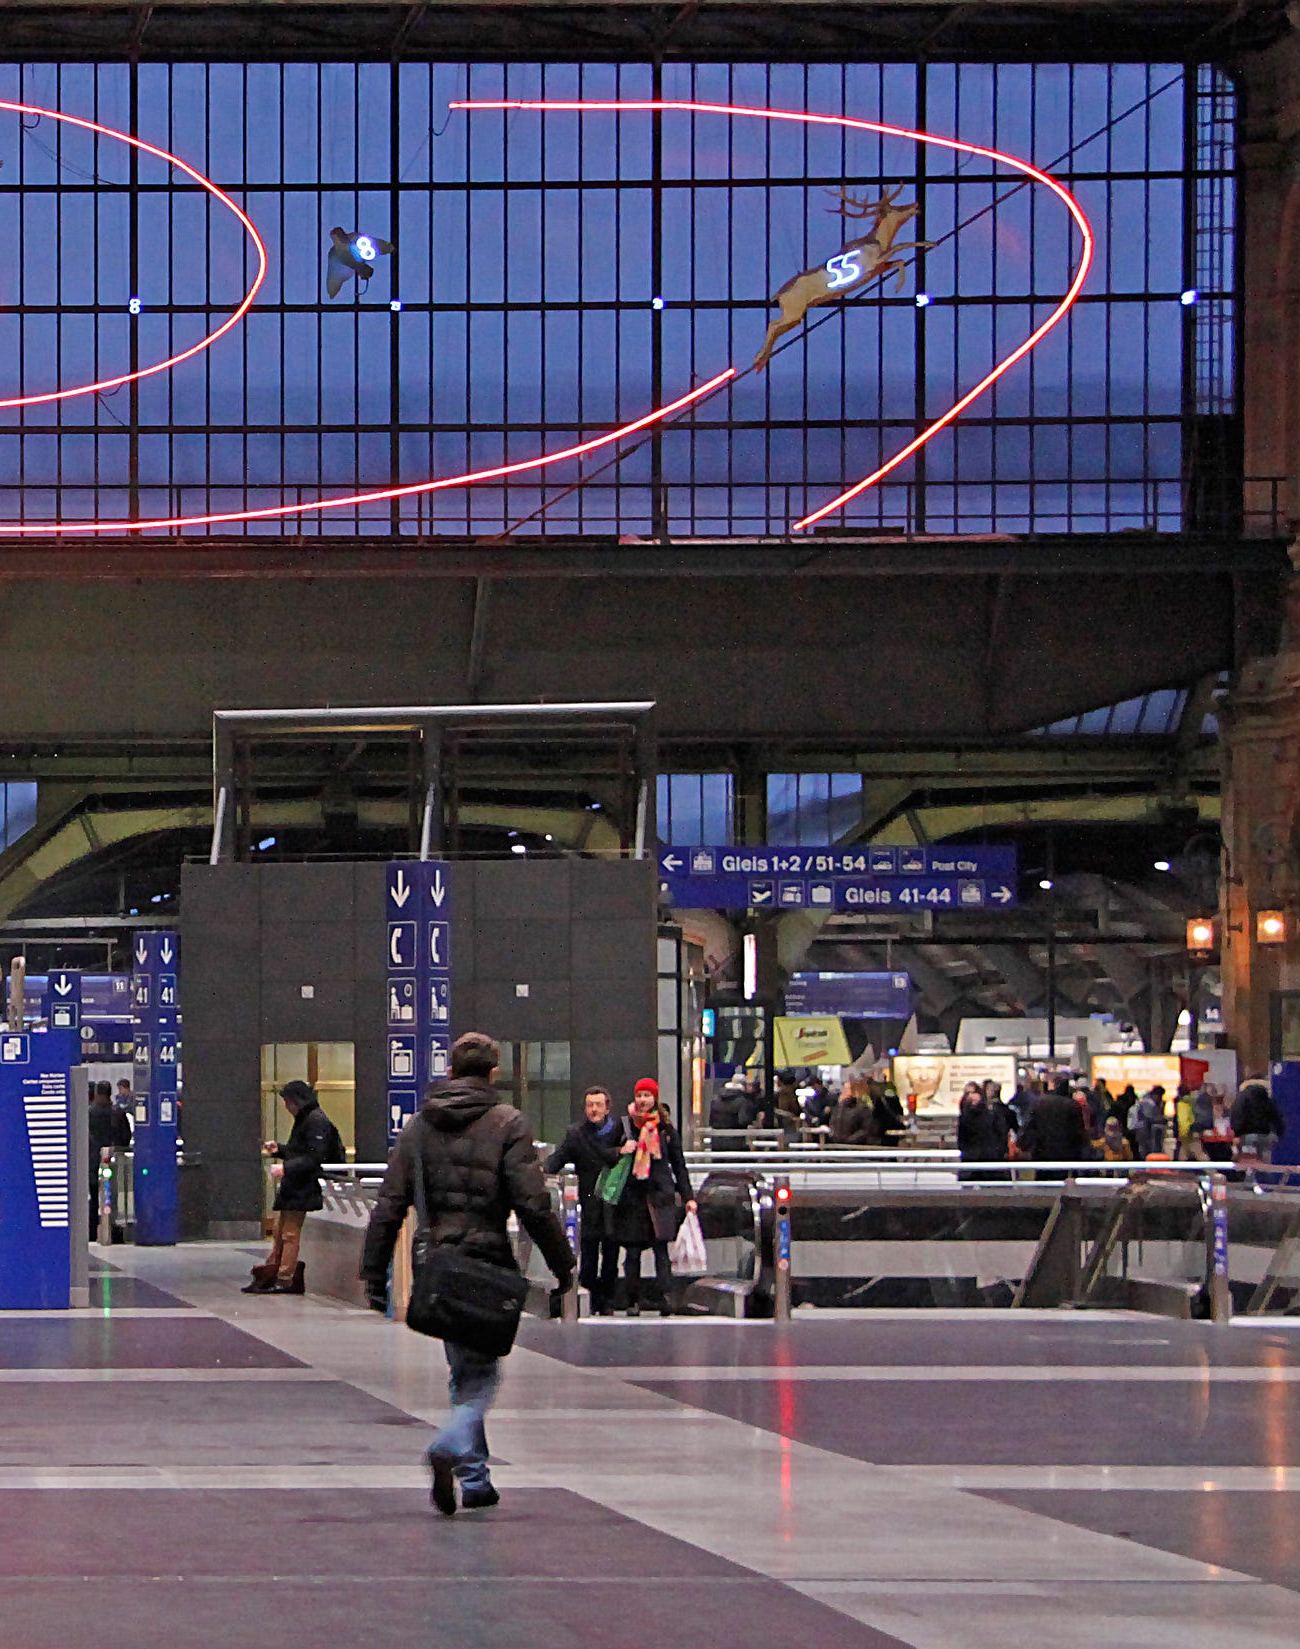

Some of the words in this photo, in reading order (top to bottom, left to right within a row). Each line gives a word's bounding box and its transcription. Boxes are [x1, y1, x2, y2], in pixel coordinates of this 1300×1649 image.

[356, 236, 376, 261] 8
[826, 249, 861, 288] 55
[129, 298, 141, 314] 8
[722, 855, 768, 872] Gleis
[772, 855, 801, 872] 1+2
[816, 855, 866, 872] 51-54
[932, 861, 955, 872] Post
[957, 861, 978, 873] City
[845, 887, 892, 904] Gleis
[899, 887, 951, 904] 41-44
[136, 987, 148, 1003] 41
[161, 987, 174, 1003] 41
[135, 1046, 148, 1062] 44
[160, 1046, 174, 1062] 44
